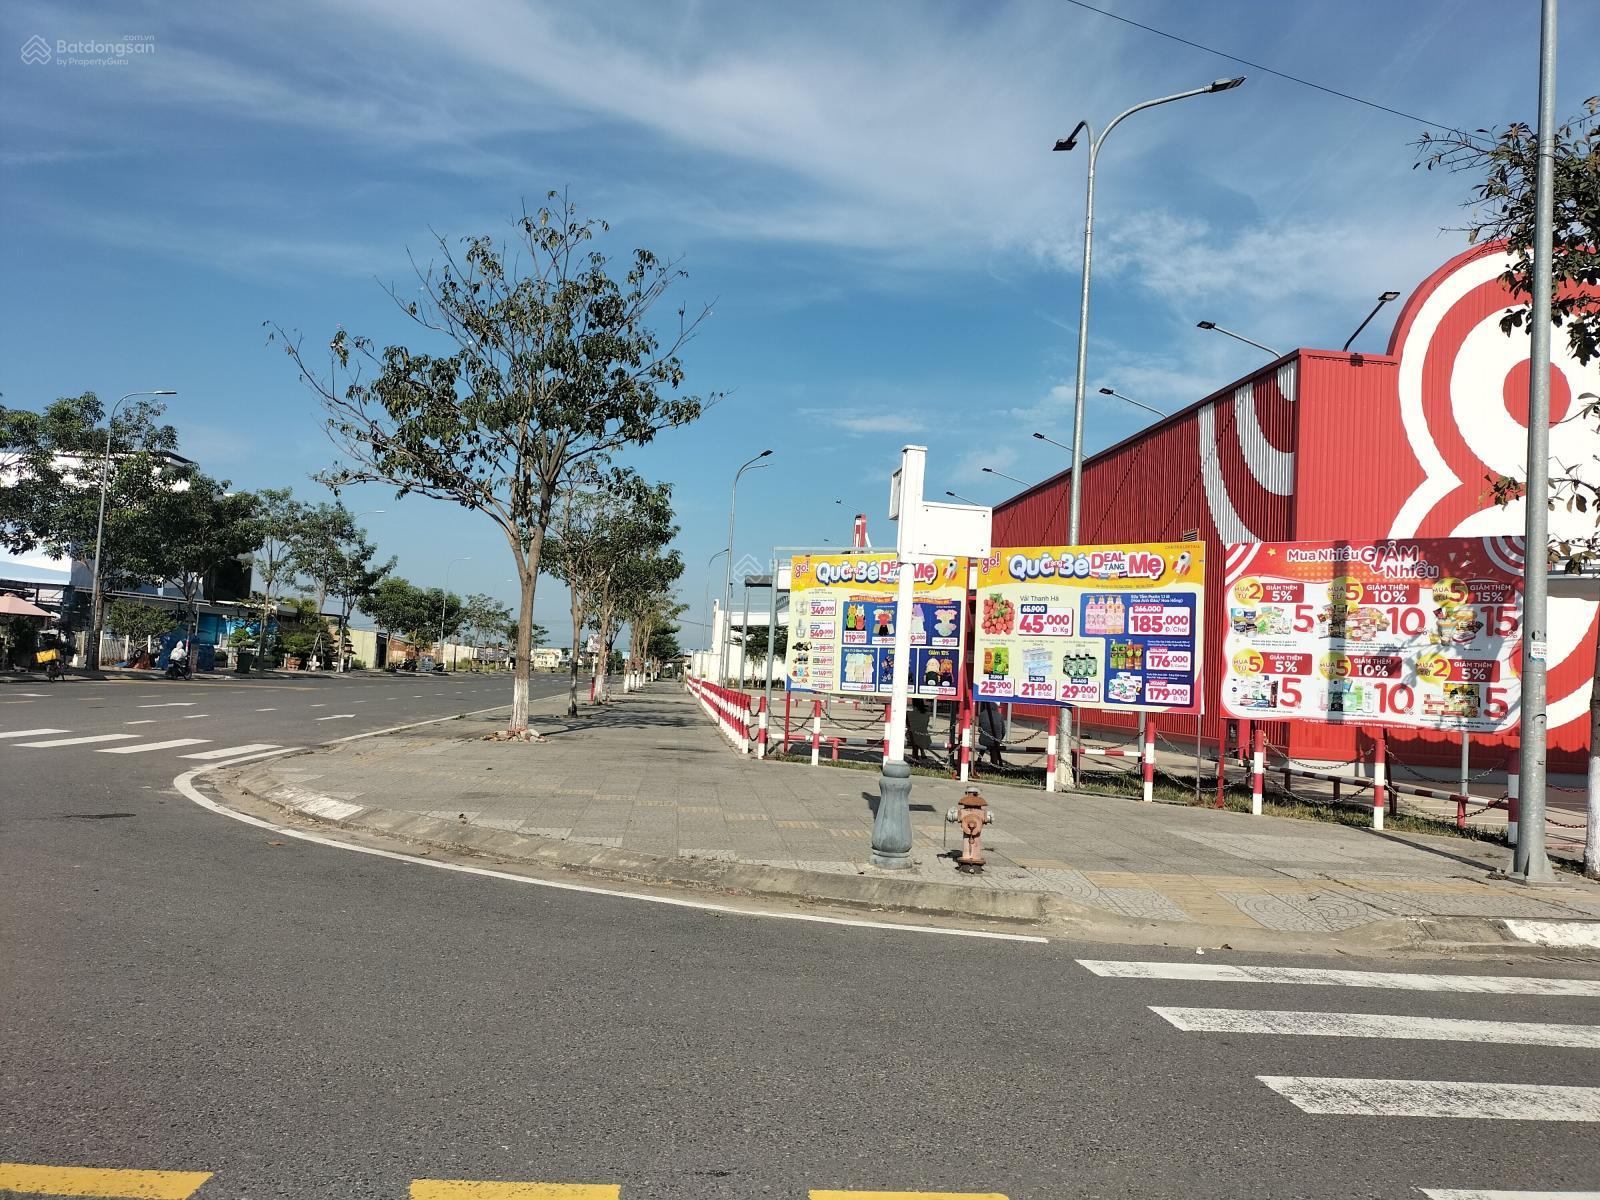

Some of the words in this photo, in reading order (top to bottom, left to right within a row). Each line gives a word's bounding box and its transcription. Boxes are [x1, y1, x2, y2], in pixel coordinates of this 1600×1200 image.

[1091, 552, 1125, 569] DEAL
[1288, 550, 1316, 562] Mua
[1318, 546, 1359, 562] Nhiều
[795, 561, 810, 578] go!
[982, 551, 1000, 574] go!
[1058, 552, 1090, 579] Bé
[1128, 554, 1162, 576] Mẹ
[1386, 560, 1438, 578] Nhiều
[1249, 583, 1261, 599] 2
[1272, 591, 1292, 601] 5%
[1345, 583, 1360, 600] 5
[1373, 591, 1407, 603] 10%
[1450, 583, 1465, 602] 5
[1476, 592, 1503, 602] 15%
[1020, 614, 1069, 633] 45.000
[1131, 615, 1188, 633] 185.000
[1149, 655, 1188, 667] 176.000
[1248, 656, 1261, 672] 5
[1275, 661, 1298, 672] 5%
[1335, 660, 1348, 676] 5
[1433, 659, 1448, 677] 2
[1356, 665, 1388, 677] 10%
[1462, 668, 1486, 680] 5%
[981, 681, 1011, 694] 25.900
[1022, 683, 1052, 696] 21.800
[1062, 685, 1097, 698] 29.000
[1148, 688, 1188, 700] 179.000
